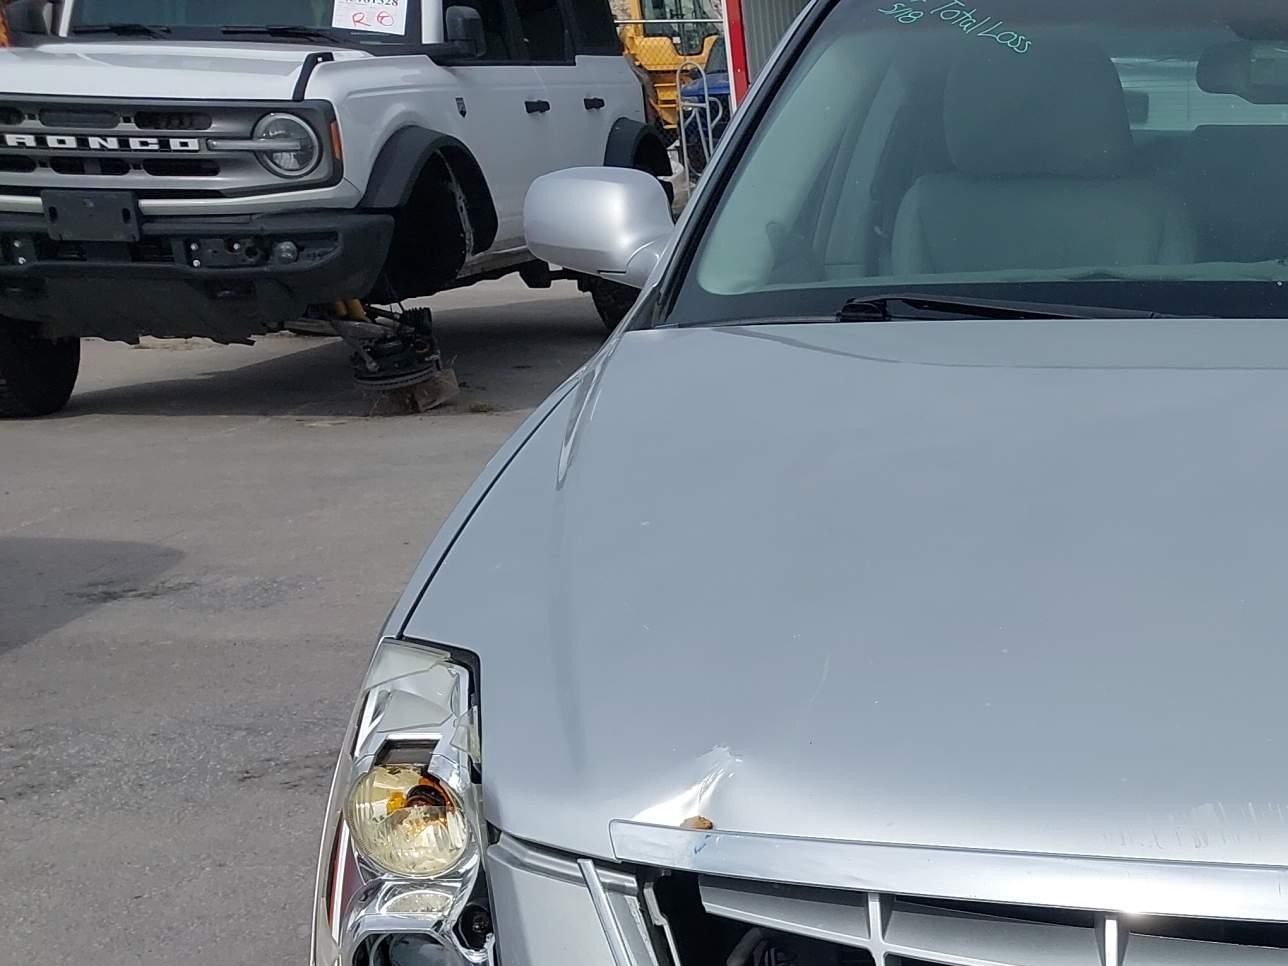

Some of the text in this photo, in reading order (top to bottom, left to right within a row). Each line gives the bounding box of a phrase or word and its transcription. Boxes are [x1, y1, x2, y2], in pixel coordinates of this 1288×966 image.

[878, 3, 924, 24] 5/18
[930, 0, 1032, 53] Total Loss
